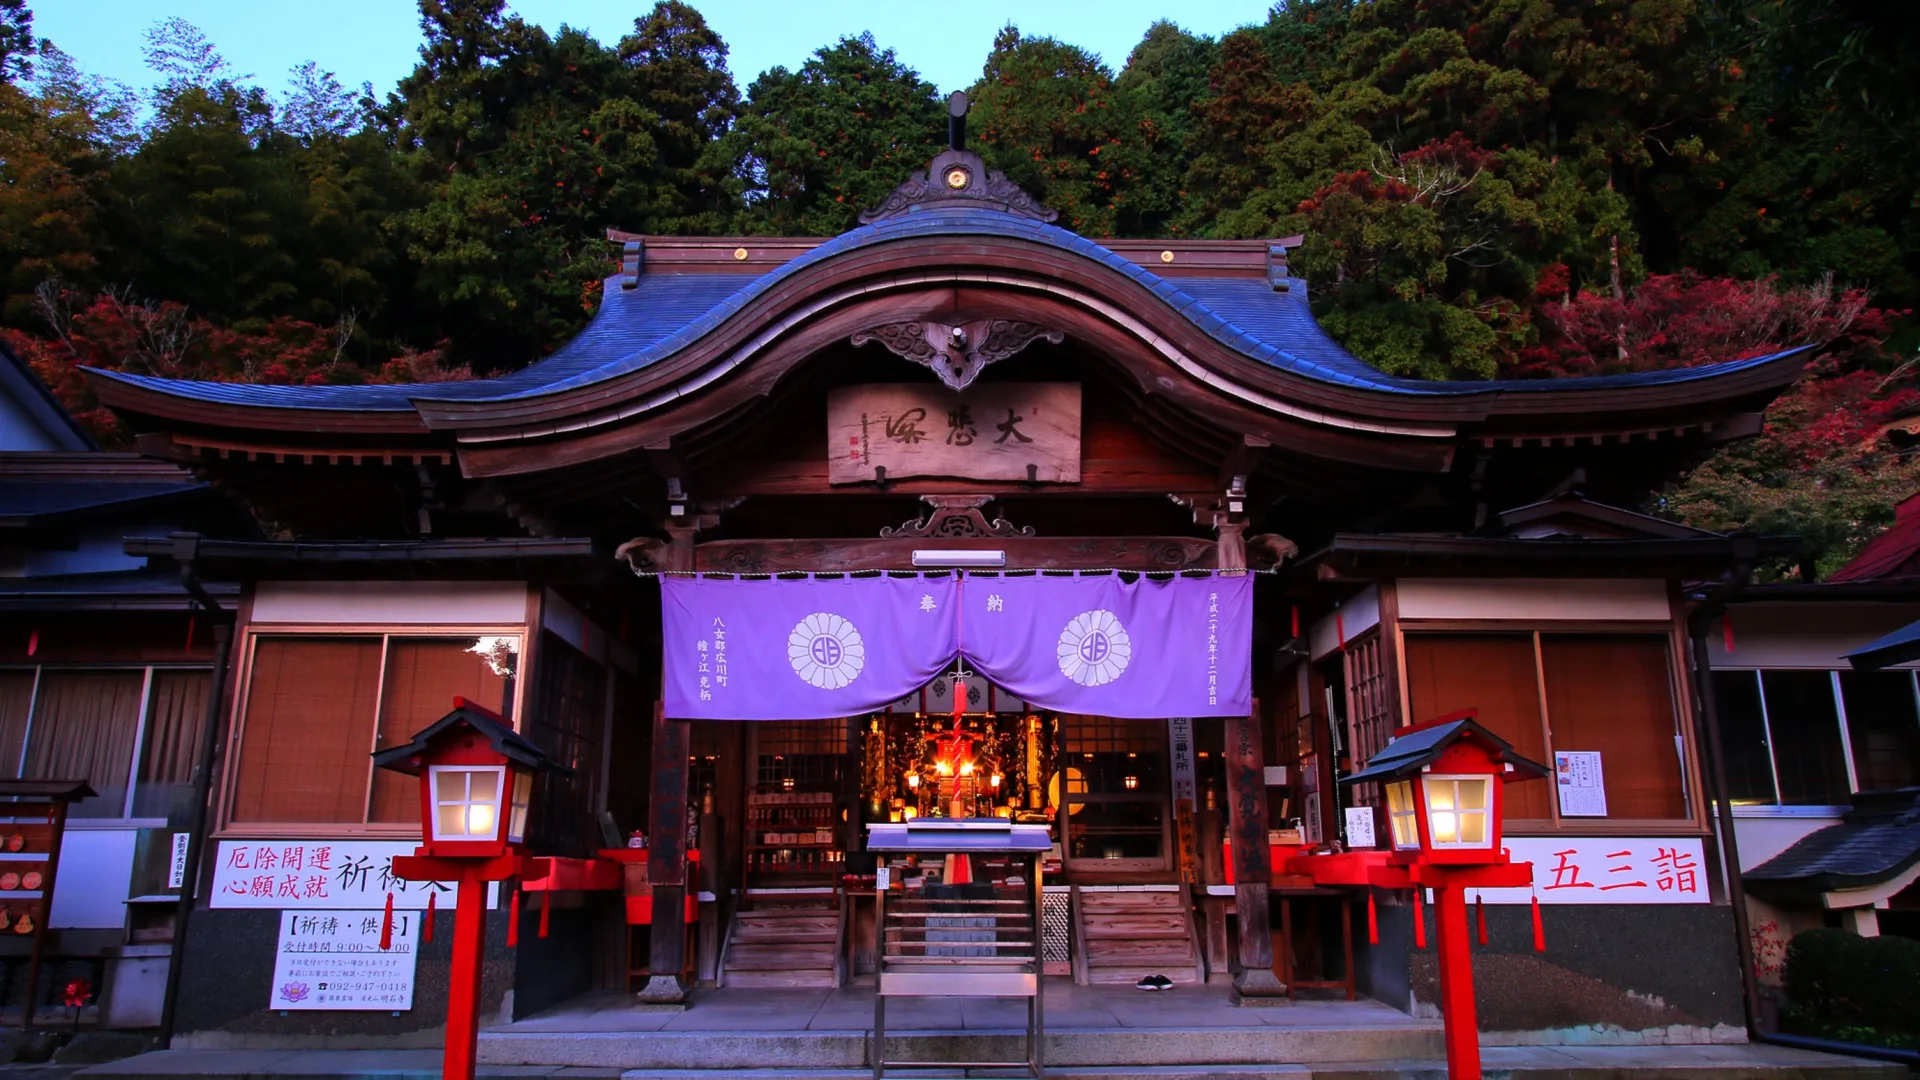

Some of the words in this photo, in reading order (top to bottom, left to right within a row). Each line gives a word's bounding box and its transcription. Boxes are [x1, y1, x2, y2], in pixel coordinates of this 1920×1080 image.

[713, 616, 728, 687] 八女郡広川町
[1207, 592, 1219, 706] 平成二十九年十二月吉日
[226, 846, 332, 871] 厄除開運
[222, 874, 329, 900] 心願成就
[283, 941, 331, 952] 受付時間
[329, 982, 407, 992] 092-947-0418
